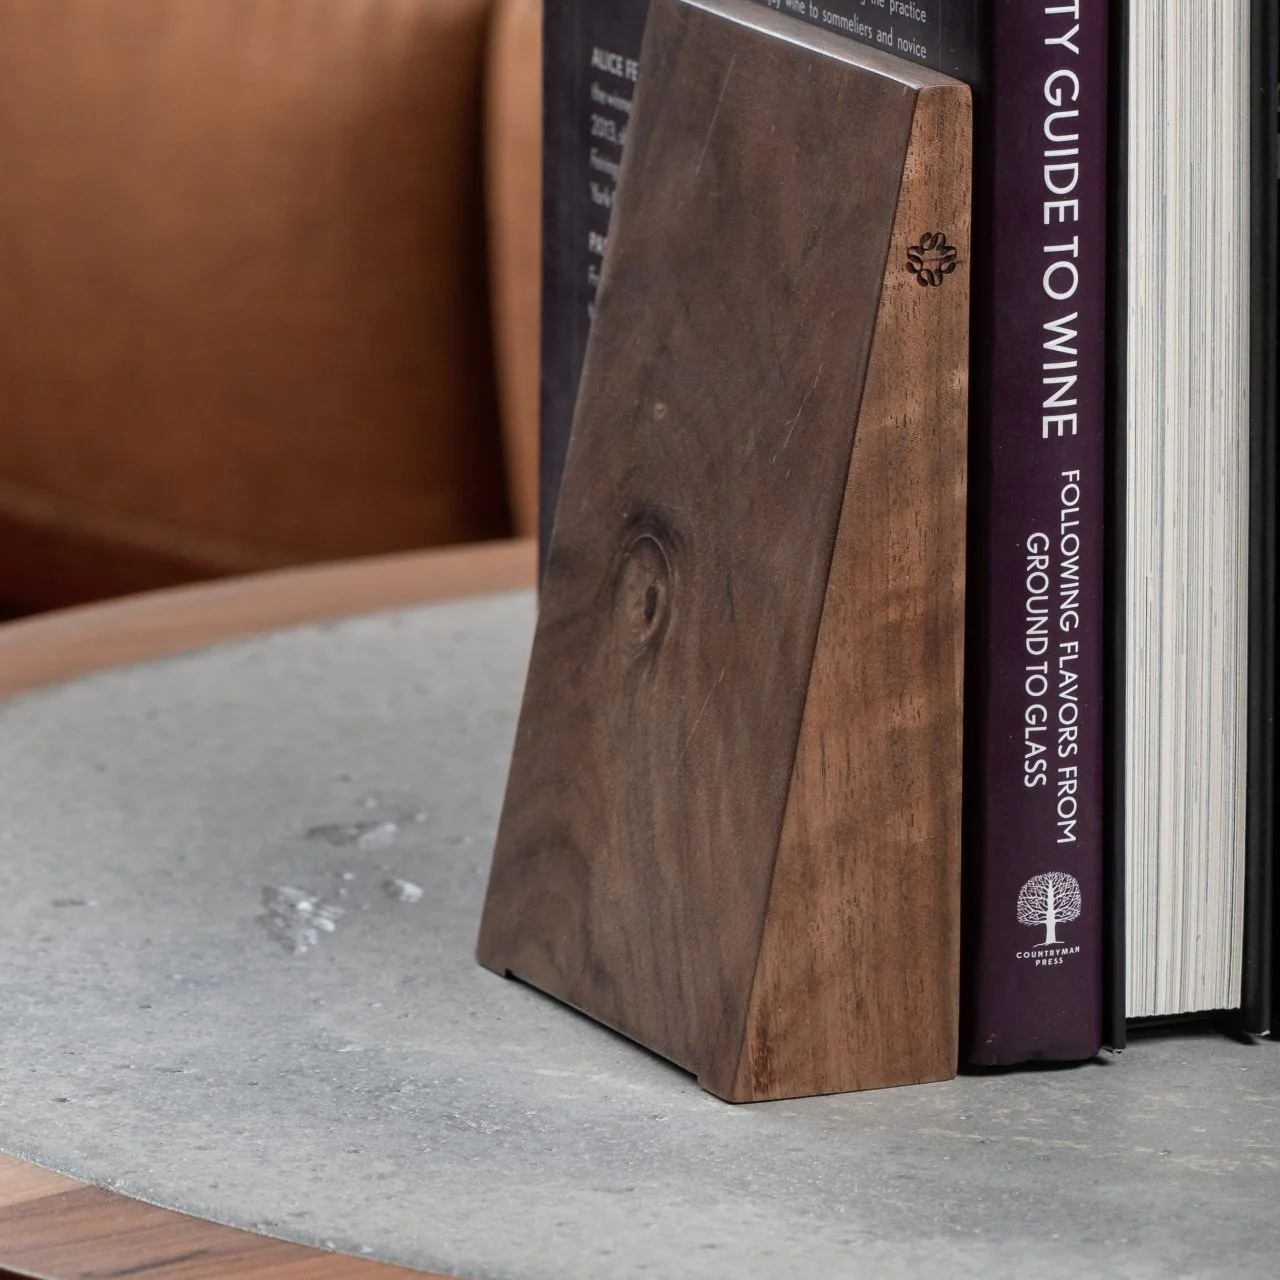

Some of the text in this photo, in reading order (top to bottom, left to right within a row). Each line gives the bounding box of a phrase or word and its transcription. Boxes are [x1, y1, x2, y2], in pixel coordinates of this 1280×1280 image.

[809, 0, 818, 19] to
[823, 9, 872, 39] sommeliers
[877, 27, 892, 47] and
[898, 37, 926, 59] novice
[890, 0, 926, 23] practice
[1043, 70, 1079, 225] GUIDE
[1043, 236, 1078, 300] TO
[1042, 312, 1078, 439] WINE
[1024, 533, 1049, 788] GROUND TO GLASS
[1056, 470, 1079, 844] FOLLOWING FLAVORS FROM
[1016, 946, 1080, 958] COUNTRYMAN
[1036, 957, 1063, 966] PRESS
